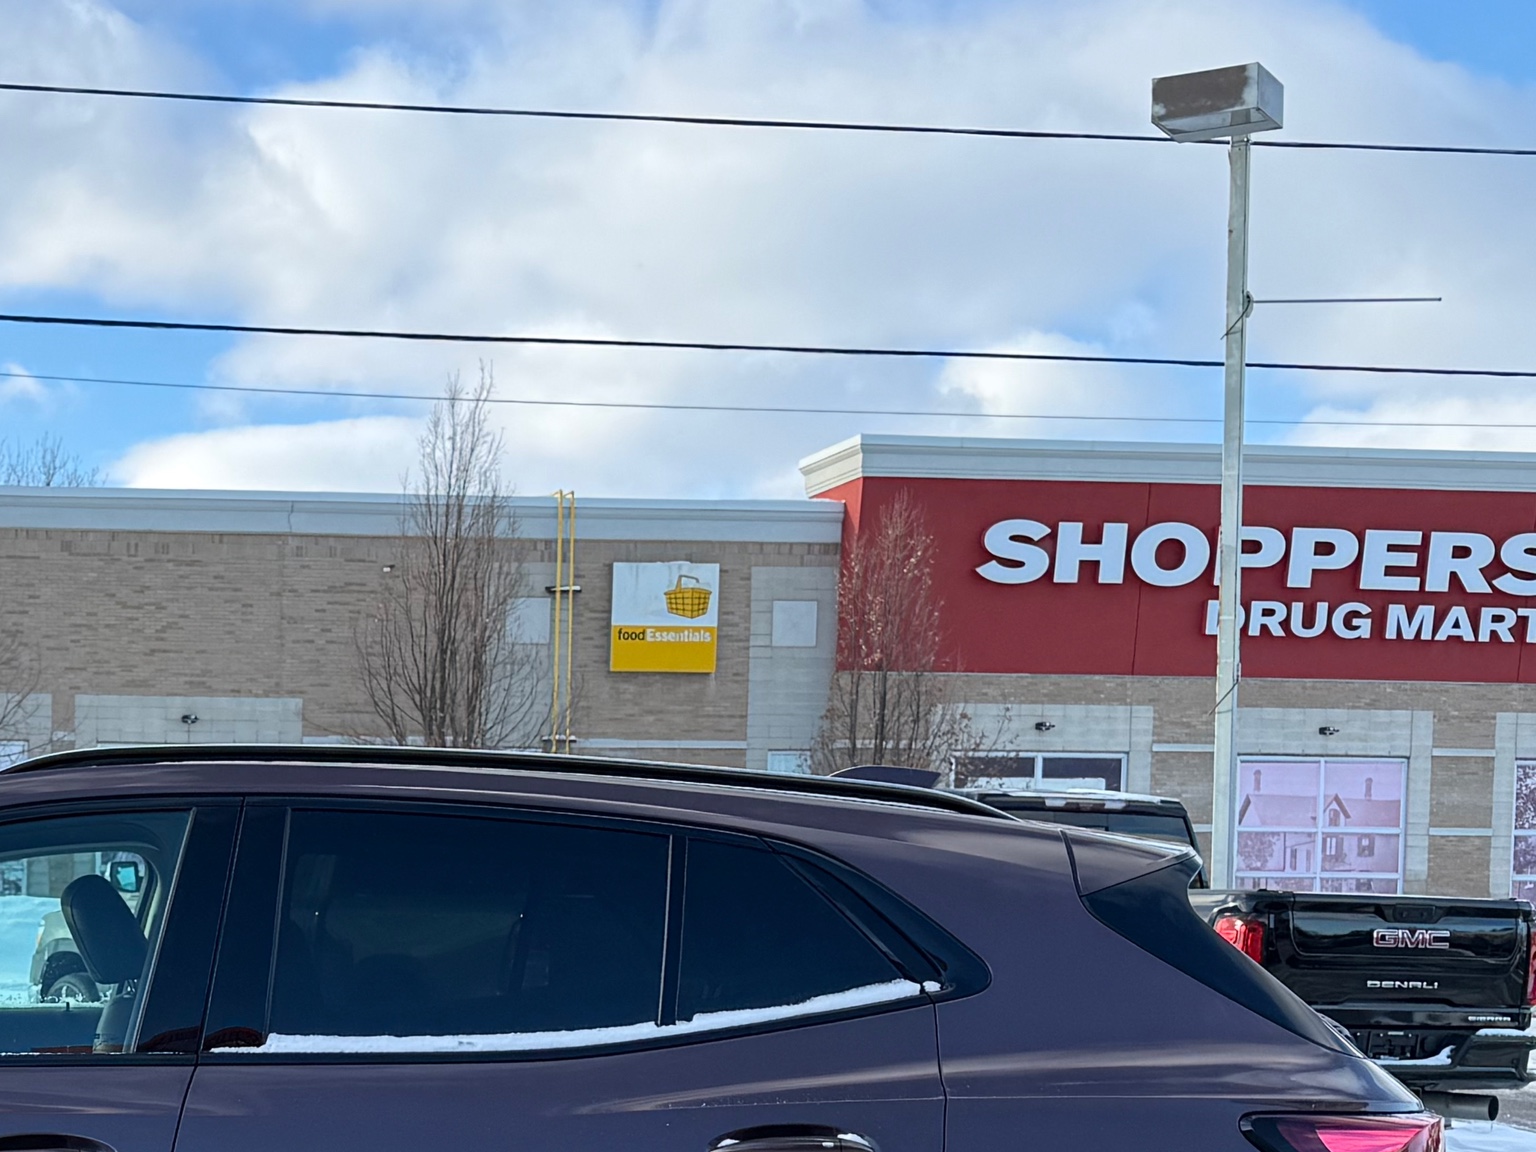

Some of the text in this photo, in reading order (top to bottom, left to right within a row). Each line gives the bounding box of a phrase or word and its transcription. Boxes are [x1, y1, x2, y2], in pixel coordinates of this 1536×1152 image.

[975, 518, 1536, 597] SHOPPERS
[1384, 603, 1536, 644] MART
[1372, 928, 1451, 949] GMC
[1366, 980, 1439, 990] DENALI
